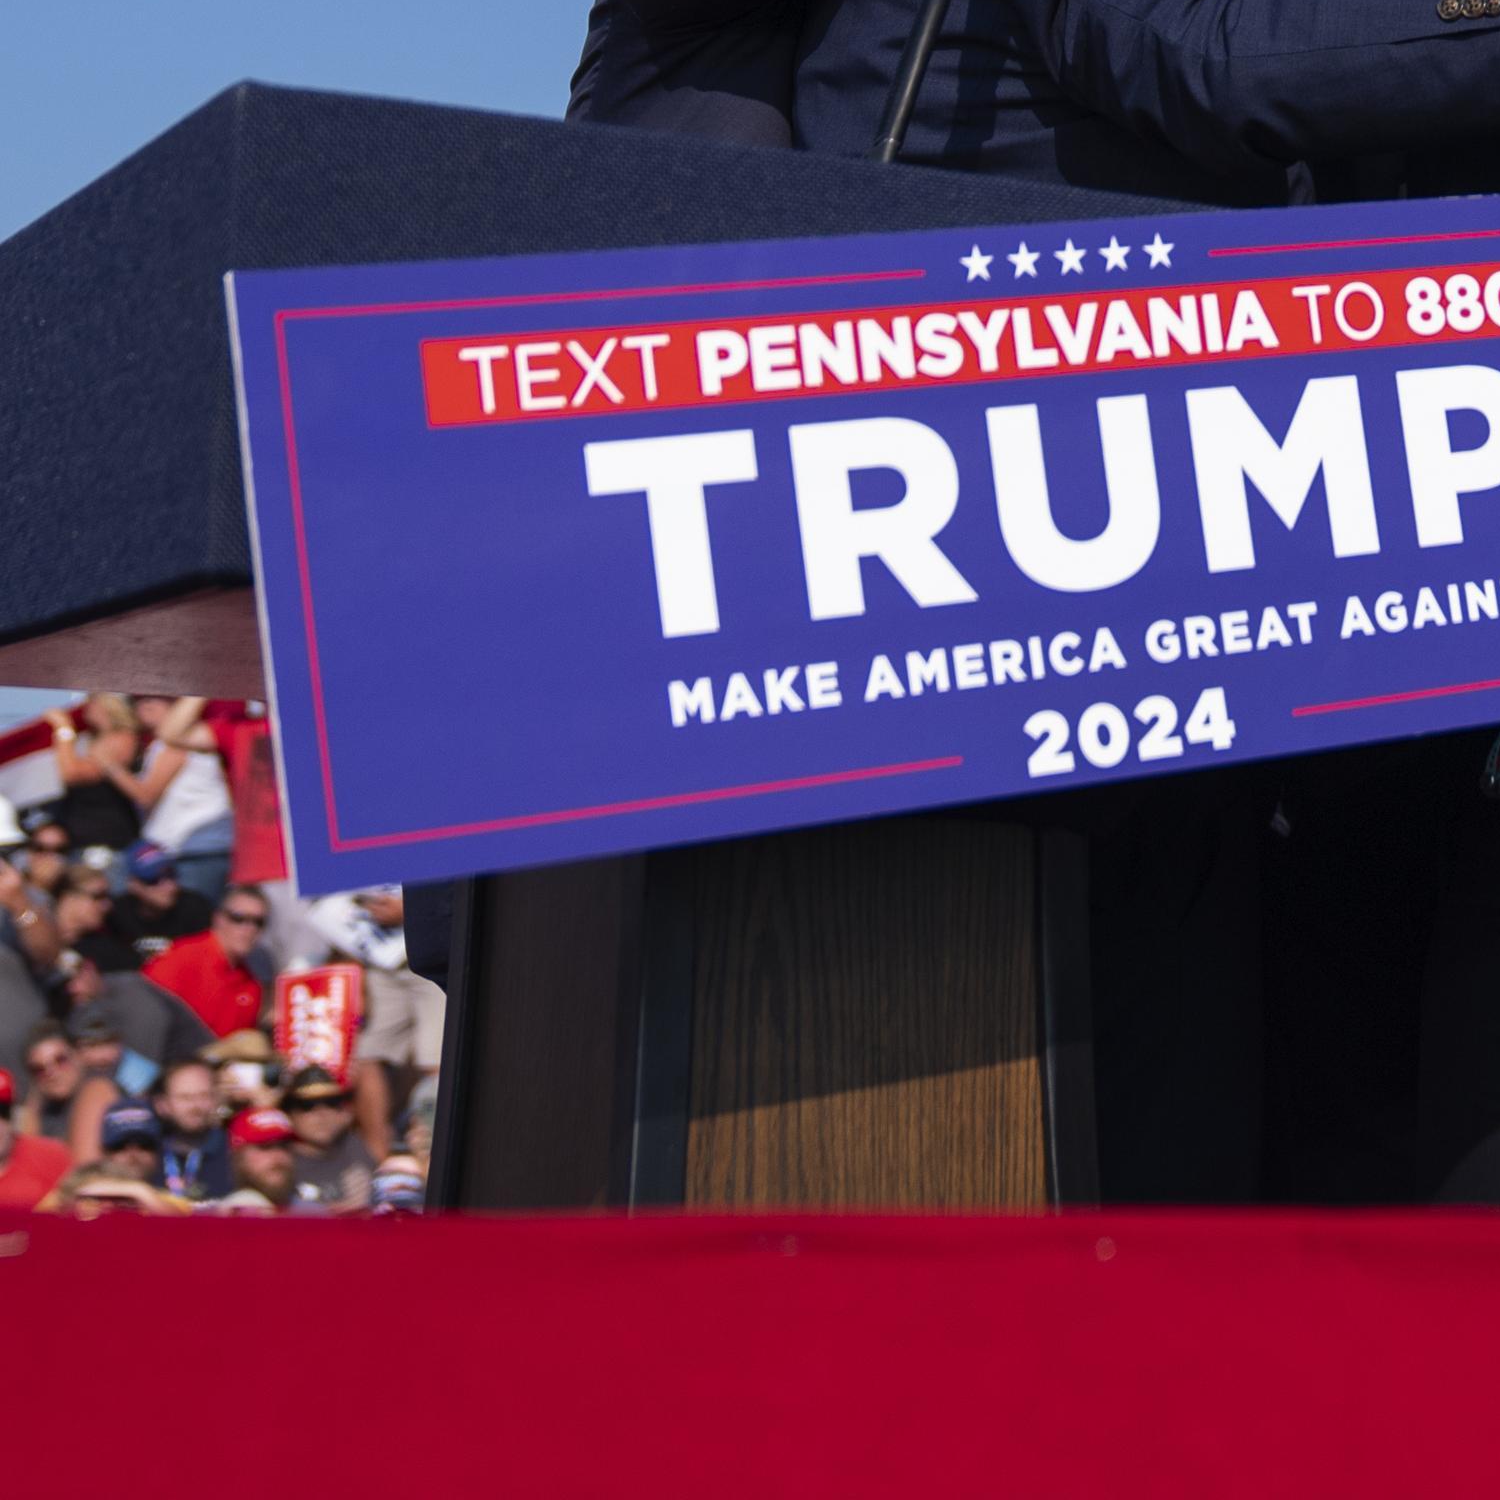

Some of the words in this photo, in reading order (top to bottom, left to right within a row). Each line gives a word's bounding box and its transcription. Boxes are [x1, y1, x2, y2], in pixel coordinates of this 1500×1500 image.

[459, 334, 671, 414] TEXT
[696, 288, 1280, 396] PENNSYLVANIA
[1291, 283, 1385, 346] TO
[667, 654, 844, 729] MAKE
[863, 619, 1128, 704] AMERICA
[1143, 600, 1318, 666] GREAT
[1022, 686, 1237, 779] 2024
